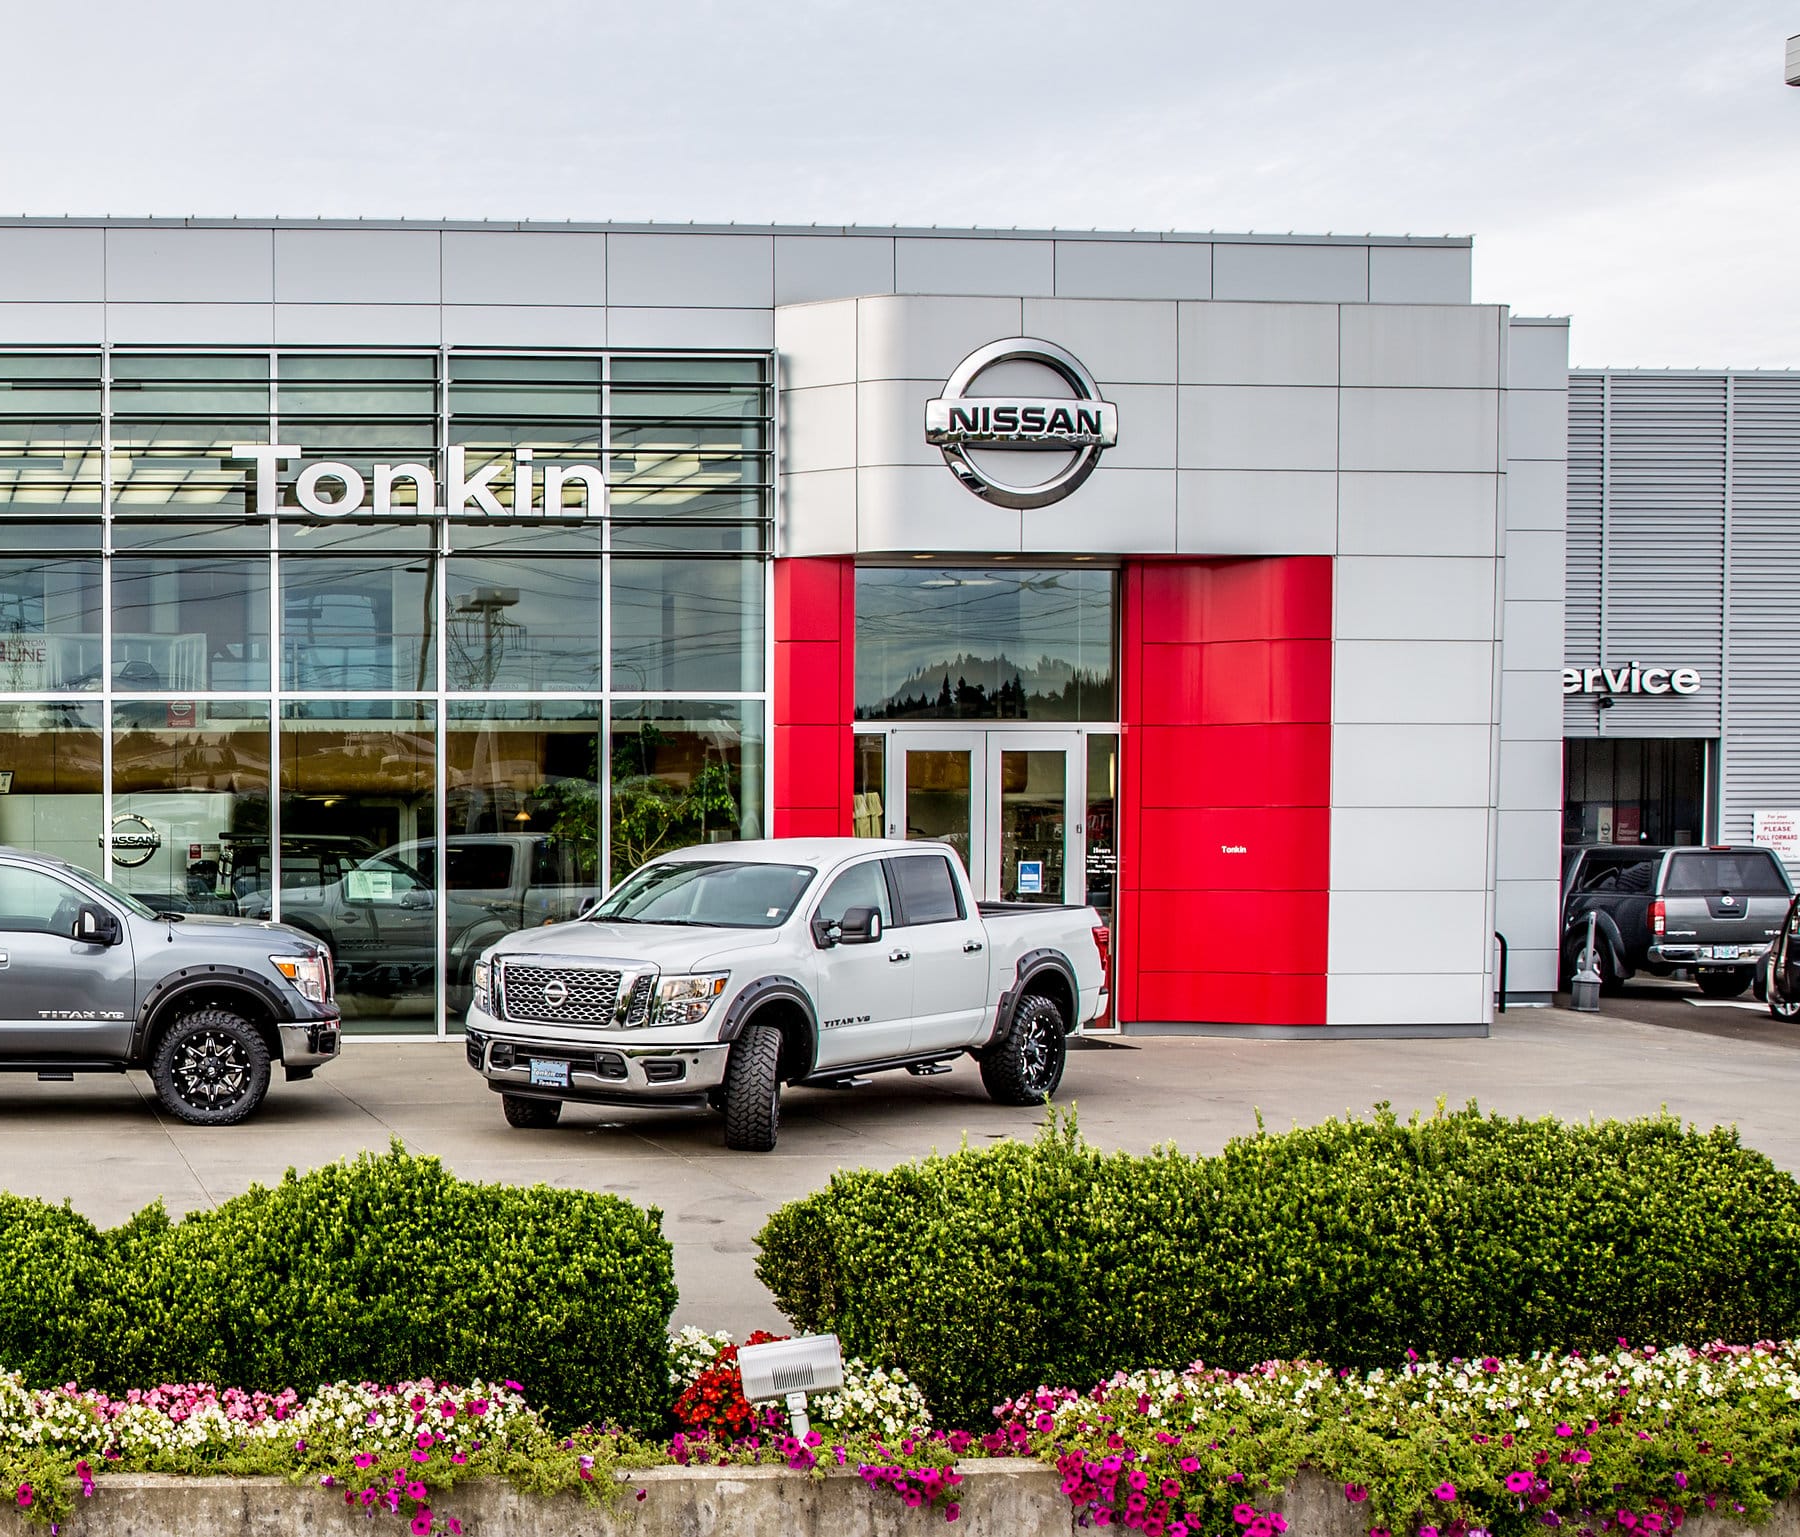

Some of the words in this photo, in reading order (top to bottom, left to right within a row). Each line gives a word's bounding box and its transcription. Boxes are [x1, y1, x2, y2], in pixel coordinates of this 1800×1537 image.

[949, 406, 1102, 435] NISSAN
[231, 444, 606, 517] Tonkin
[1562, 660, 1702, 694] ervice
[111, 836, 155, 846] ISSAN
[1221, 845, 1247, 854] Tonkin
[38, 1010, 97, 1019] TITAN
[823, 1017, 854, 1028] TITAN
